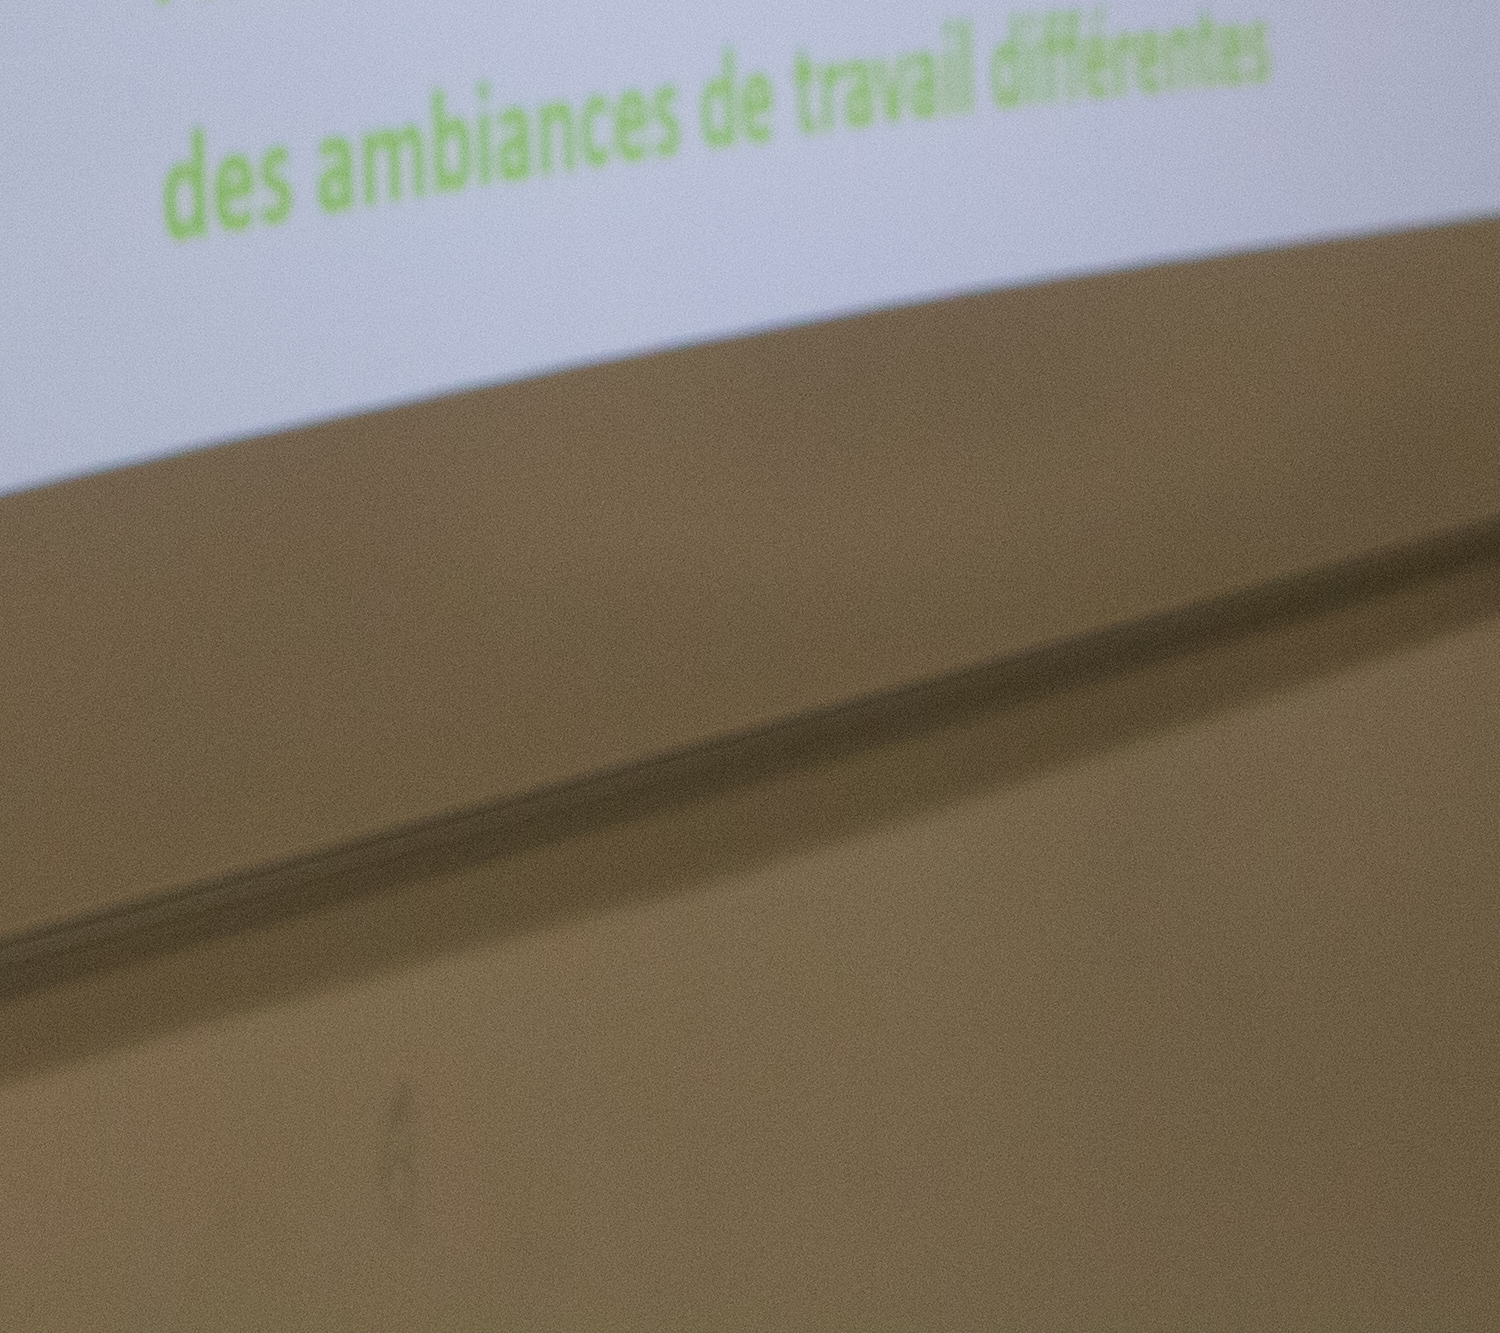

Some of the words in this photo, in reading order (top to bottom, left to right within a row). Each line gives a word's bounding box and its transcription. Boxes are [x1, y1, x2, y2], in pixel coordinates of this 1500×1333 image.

[161, 124, 293, 242] des
[315, 81, 681, 216] ambiances
[699, 44, 774, 151] de
[793, 18, 974, 136] travail
[989, 8, 1275, 111] différentes
